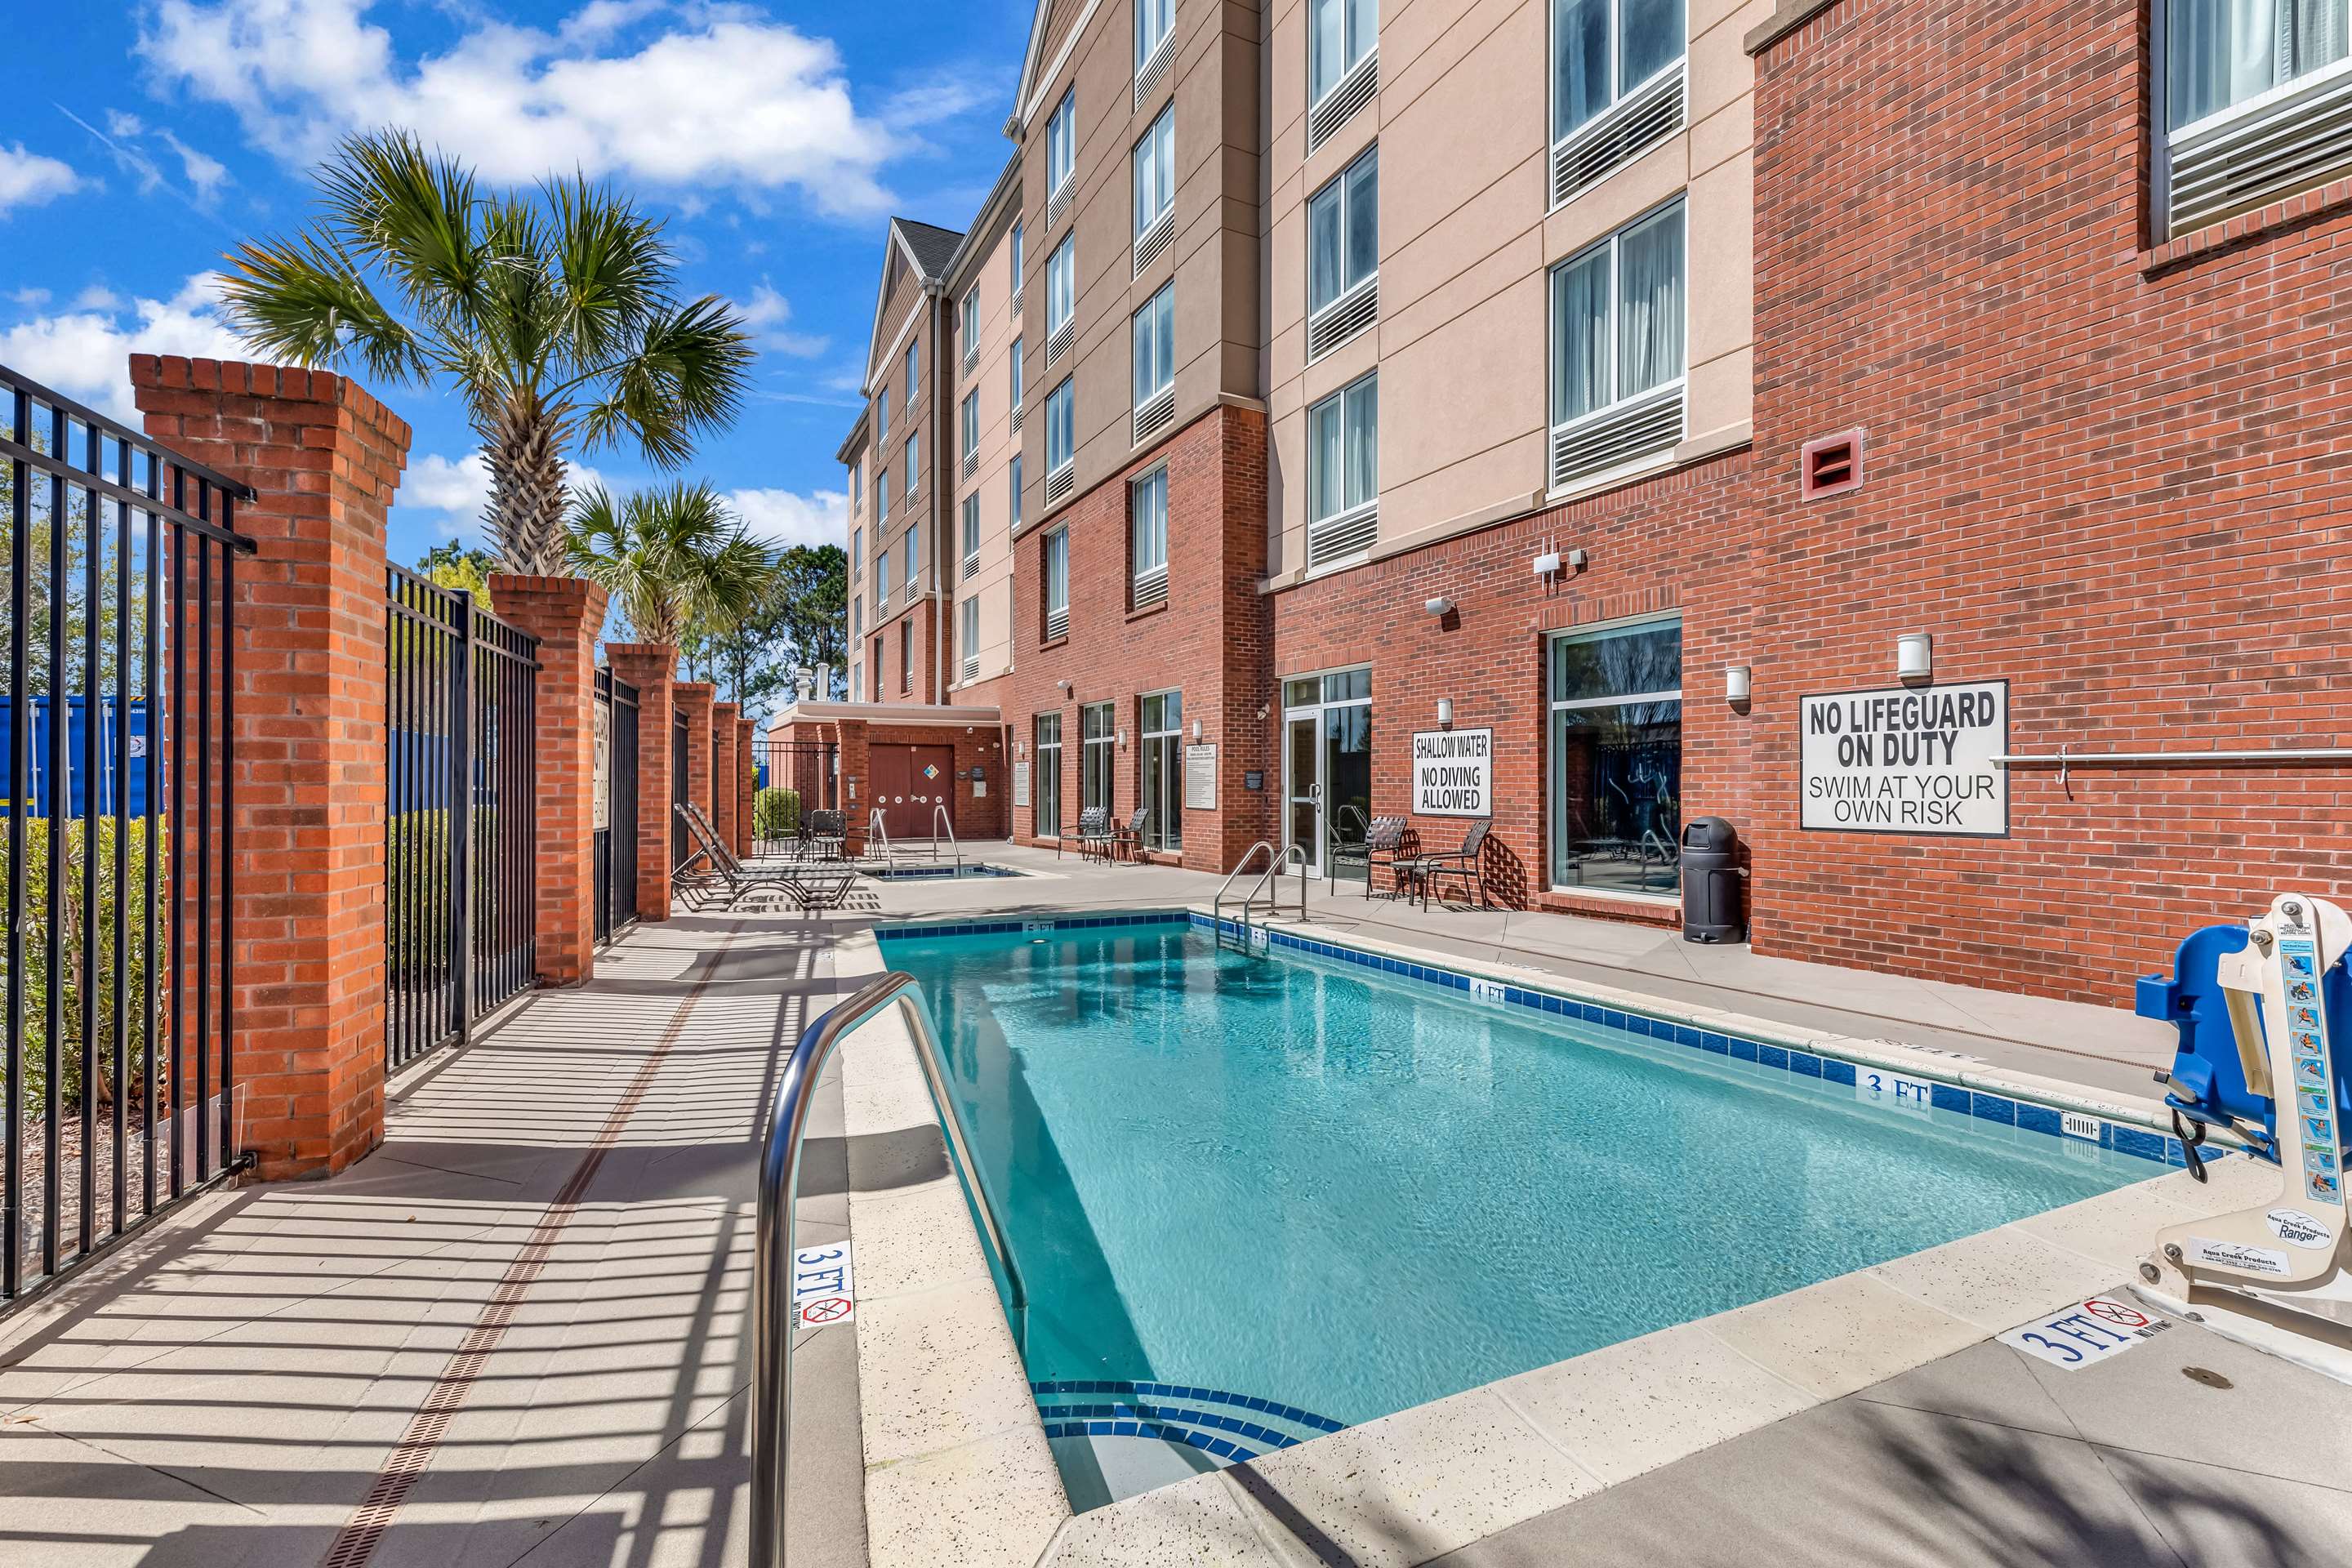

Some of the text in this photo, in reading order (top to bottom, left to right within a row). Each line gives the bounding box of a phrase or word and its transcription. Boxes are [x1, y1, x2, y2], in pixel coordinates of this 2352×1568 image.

[1811, 691, 1995, 735] NO LIFEGUARD
[1416, 734, 1487, 760] SHALLOW WATER
[1838, 730, 1959, 768] ON DUTY
[1422, 766, 1481, 787] NO DIVING
[1809, 775, 1995, 800] SWIM AT YOUR
[1422, 789, 1481, 810] ALLOWED
[1834, 800, 1963, 826] OWN RISK
[1488, 986, 1503, 999] FT
[1868, 1074, 1928, 1102] 3 FT
[2267, 1214, 2330, 1239] Aqua Creek Products
[2279, 1224, 2318, 1242] Ranger
[797, 1250, 844, 1265] 3
[2203, 1249, 2277, 1266] Aqua Creek Products
[796, 1266, 846, 1297] FT
[2021, 1312, 2132, 1362] 3 FT
